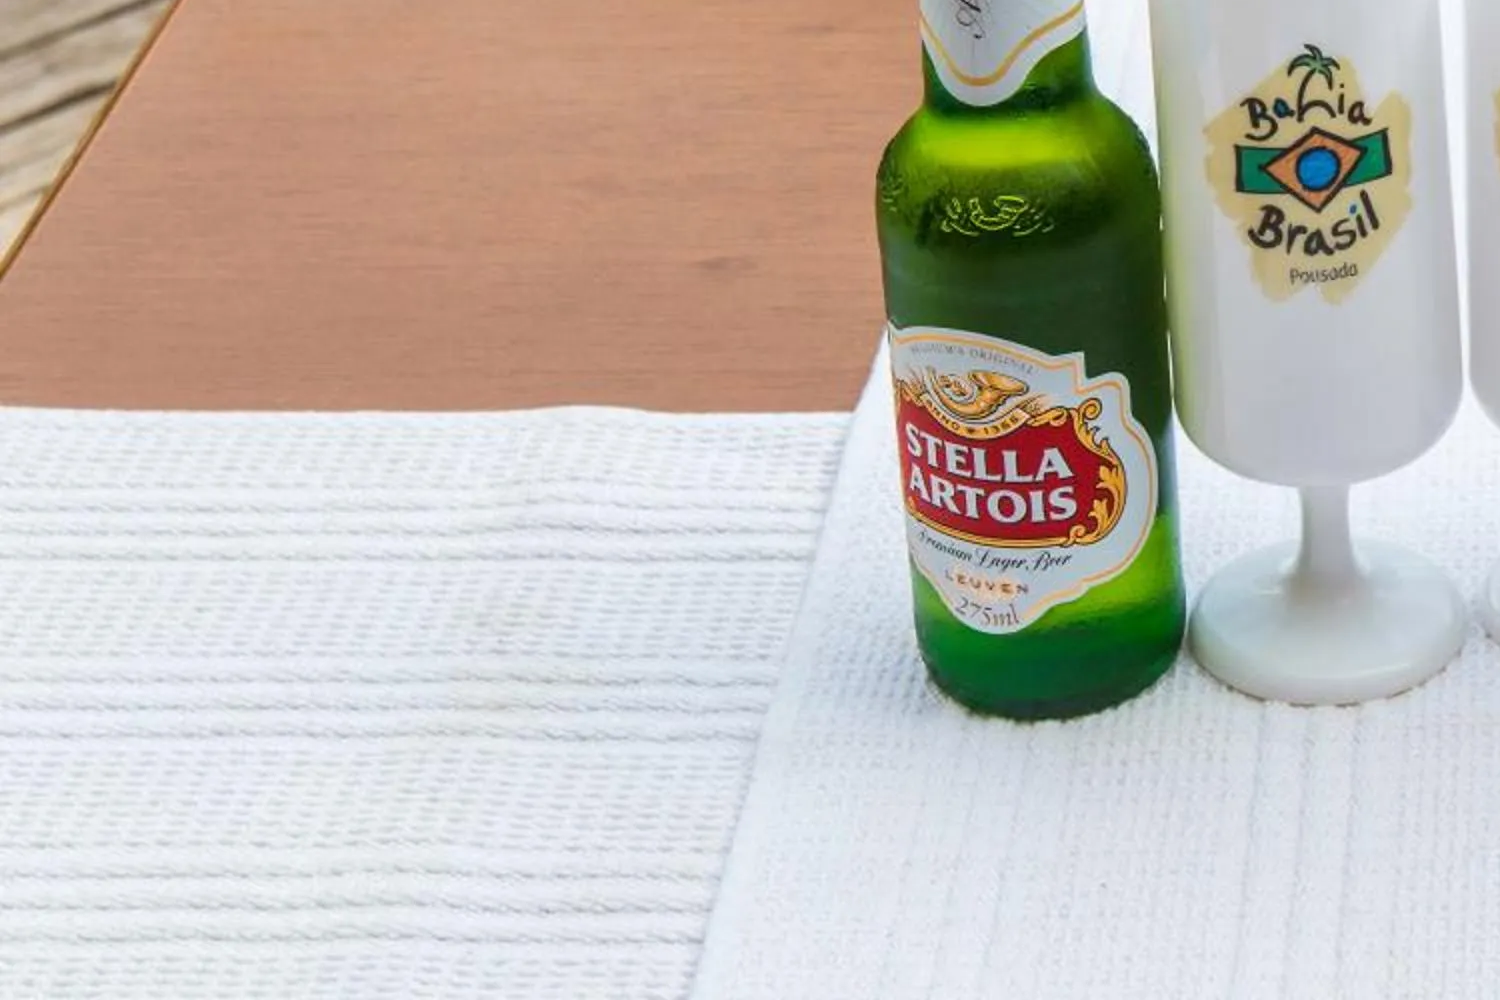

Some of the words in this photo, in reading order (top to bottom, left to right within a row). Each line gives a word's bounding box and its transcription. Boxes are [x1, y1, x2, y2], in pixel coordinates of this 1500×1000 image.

[1240, 44, 1373, 142] Bahia
[1248, 189, 1381, 257] Brasil
[1290, 262, 1359, 285] Pousada
[904, 422, 1075, 483] STELLA
[908, 463, 1078, 524] ARTOIS
[918, 528, 973, 562] Premium
[1025, 551, 1073, 571] Beer
[945, 569, 1029, 595] LEUVEN
[955, 597, 1019, 626] 275ml
